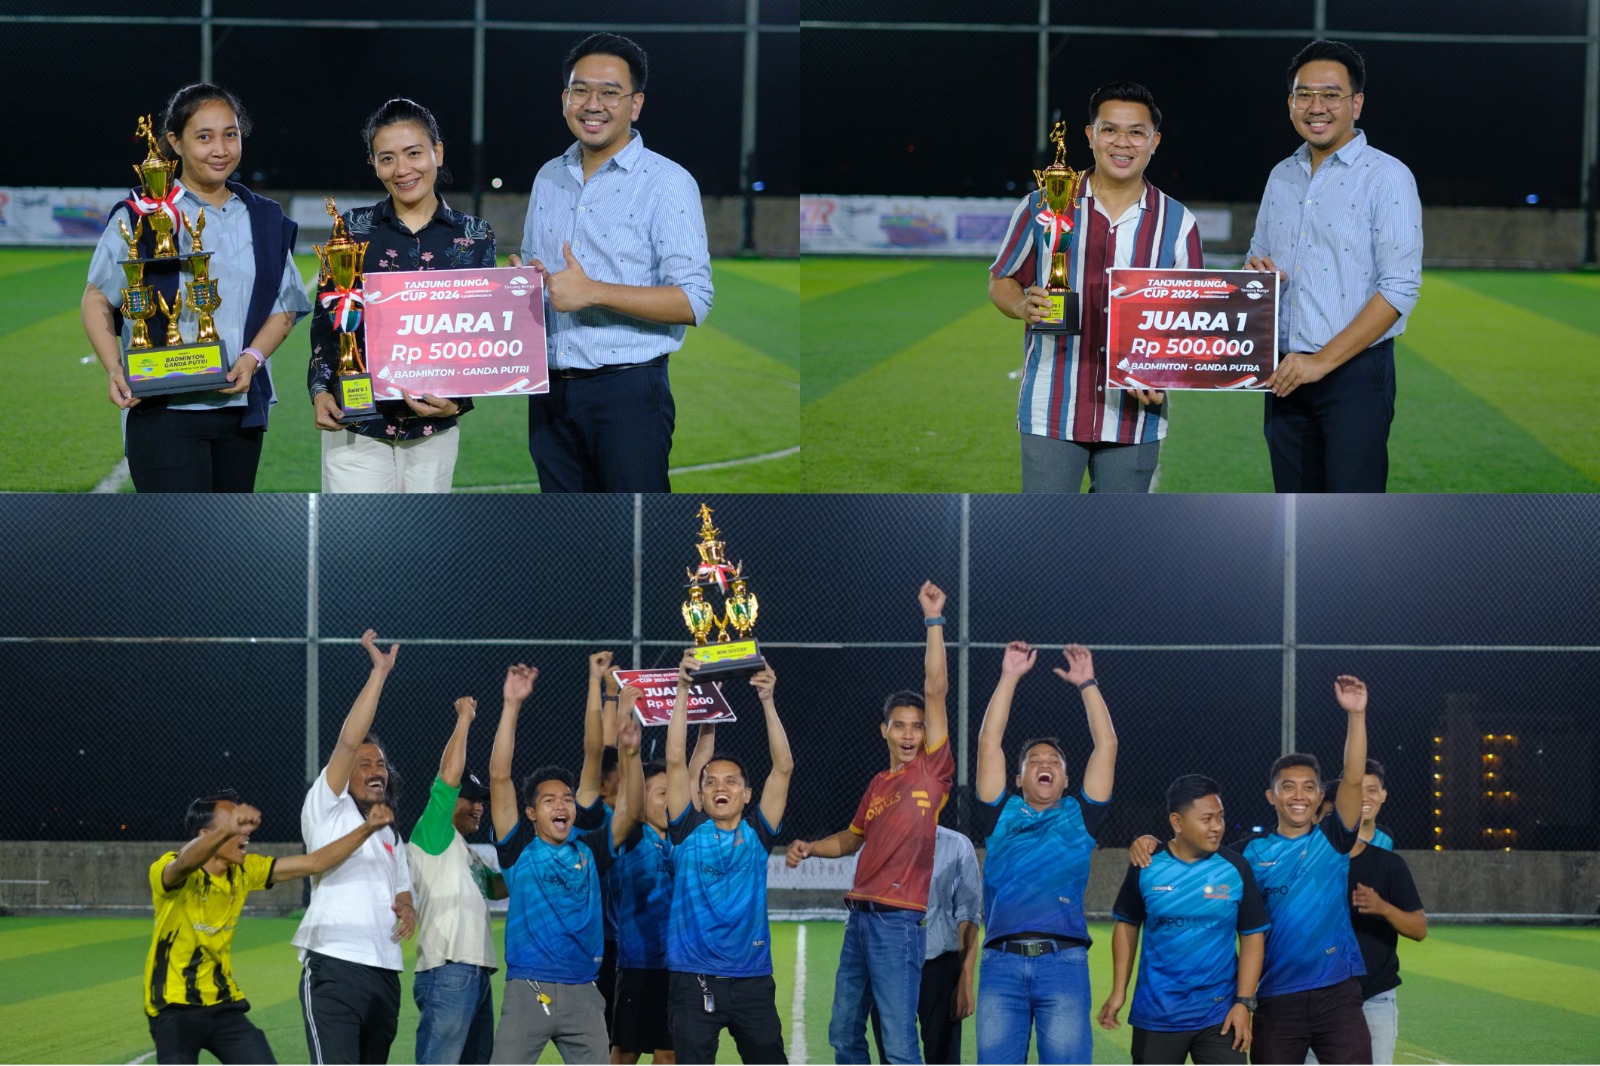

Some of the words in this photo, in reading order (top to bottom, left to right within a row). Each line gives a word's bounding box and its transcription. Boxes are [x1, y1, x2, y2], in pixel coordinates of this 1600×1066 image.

[404, 280, 451, 289] TANJUNG
[453, 279, 489, 287] BUNGA
[1148, 279, 1193, 288] TANJUNG
[1194, 280, 1228, 288] BUNGA
[400, 291, 428, 301] CUP
[430, 290, 460, 300] 2024
[1144, 289, 1169, 299] CUP
[1171, 290, 1200, 299] 2024
[397, 312, 495, 336] JUARA
[502, 311, 514, 331] 1
[1138, 311, 1229, 331] JUARA
[1236, 312, 1248, 332] 1
[391, 344, 422, 365] Rp
[428, 339, 523, 360] 500.000
[1131, 338, 1161, 358] Rp
[1166, 339, 1254, 356] 500.000
[166, 354, 204, 362] BADMINTON
[394, 369, 455, 379] BADMINTON
[463, 366, 498, 376] GANDA
[501, 365, 529, 374] PUTRI
[1131, 362, 1188, 371] BADMINTON
[1194, 363, 1228, 371] GANDA
[1229, 363, 1260, 372] PUTRA
[694, 685, 703, 695] 1
[647, 700, 664, 709] Rp
[666, 697, 714, 706] 8.000
[801, 863, 844, 875] ALPHA
